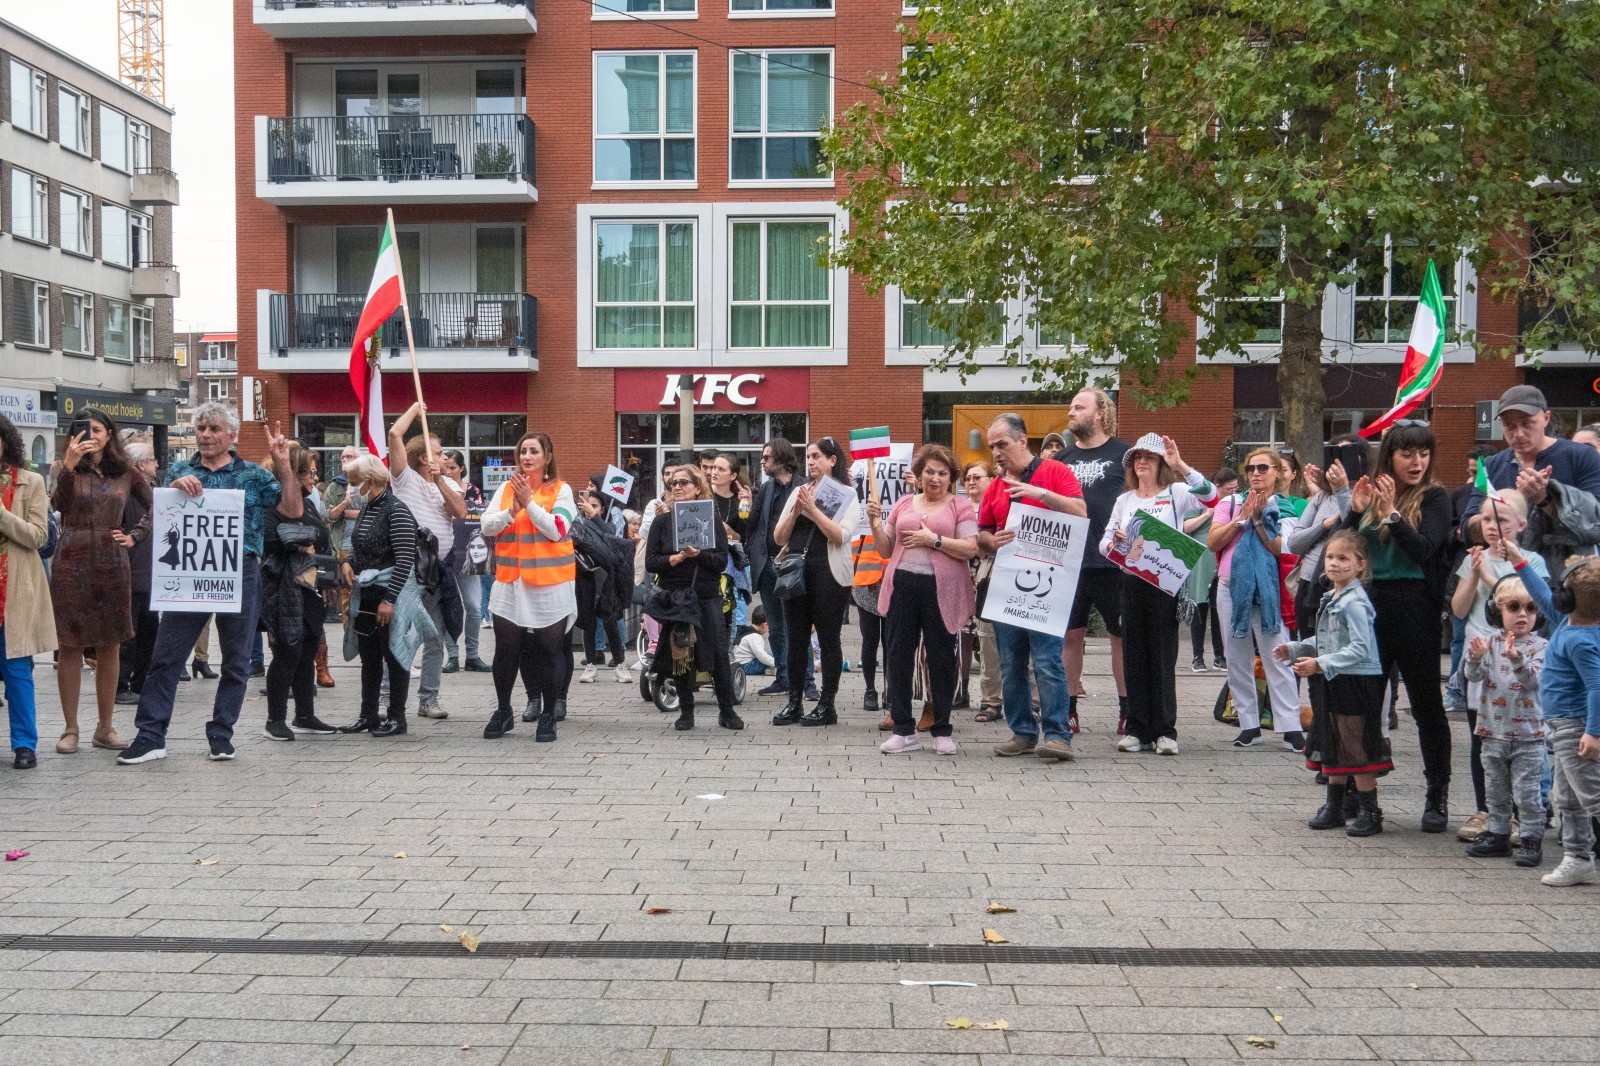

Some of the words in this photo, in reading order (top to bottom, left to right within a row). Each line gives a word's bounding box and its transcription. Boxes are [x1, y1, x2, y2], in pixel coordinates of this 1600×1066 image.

[659, 373, 761, 406] KFC
[120, 403, 144, 421] hoekje
[488, 458, 502, 467] EAT
[867, 462, 908, 480] REE
[183, 515, 239, 538] FREE
[1021, 514, 1072, 541] WOMAN
[1017, 530, 1033, 542] LIFE
[1035, 534, 1069, 550] FREEDOM
[193, 579, 234, 592] WOMAN
[1015, 566, 1055, 598] زن
[1003, 607, 1048, 624] #MAHSAAMINI
